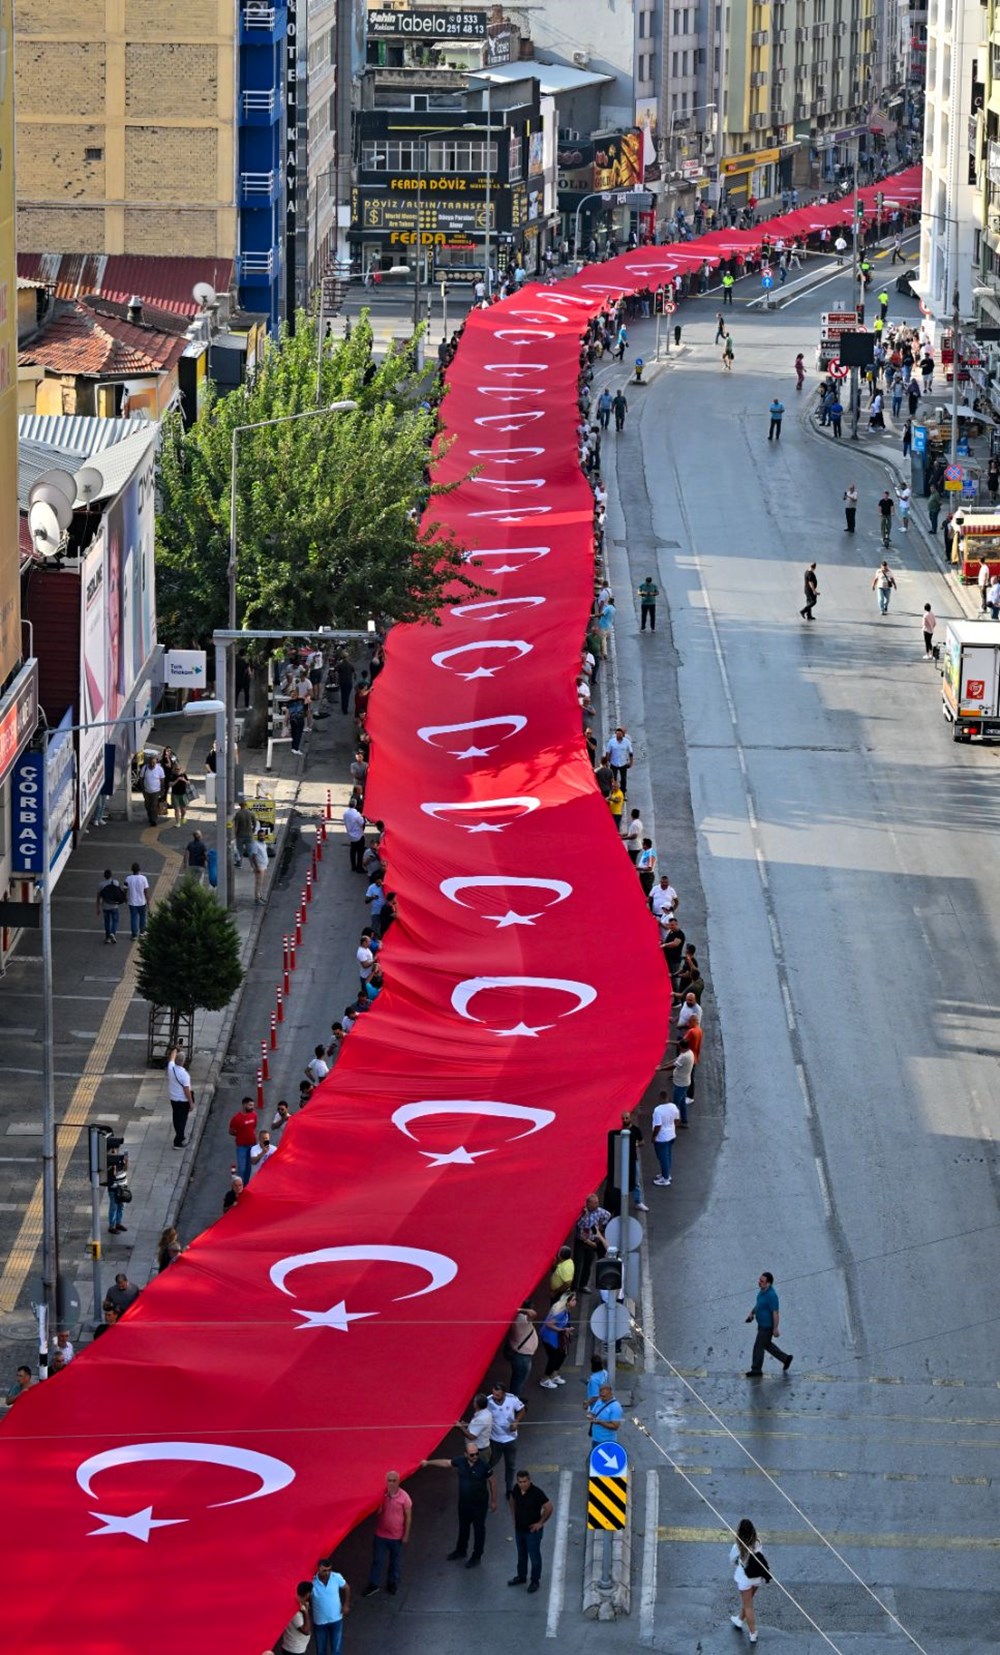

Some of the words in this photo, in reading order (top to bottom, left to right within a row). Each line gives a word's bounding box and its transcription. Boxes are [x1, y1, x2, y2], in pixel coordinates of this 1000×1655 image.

[370, 11, 396, 24] Şahin
[397, 13, 446, 33] Tabela
[456, 14, 462, 24] 0
[463, 14, 478, 24] 533
[446, 24, 461, 33] 251
[463, 25, 473, 34] 48
[474, 25, 485, 34] 13
[391, 179, 427, 190] FERDA
[429, 177, 467, 190] DÖVİZ
[364, 199, 398, 208] DÖVİZ
[390, 231, 447, 245] FERDA
[19, 766, 38, 870] ÇORBACI
